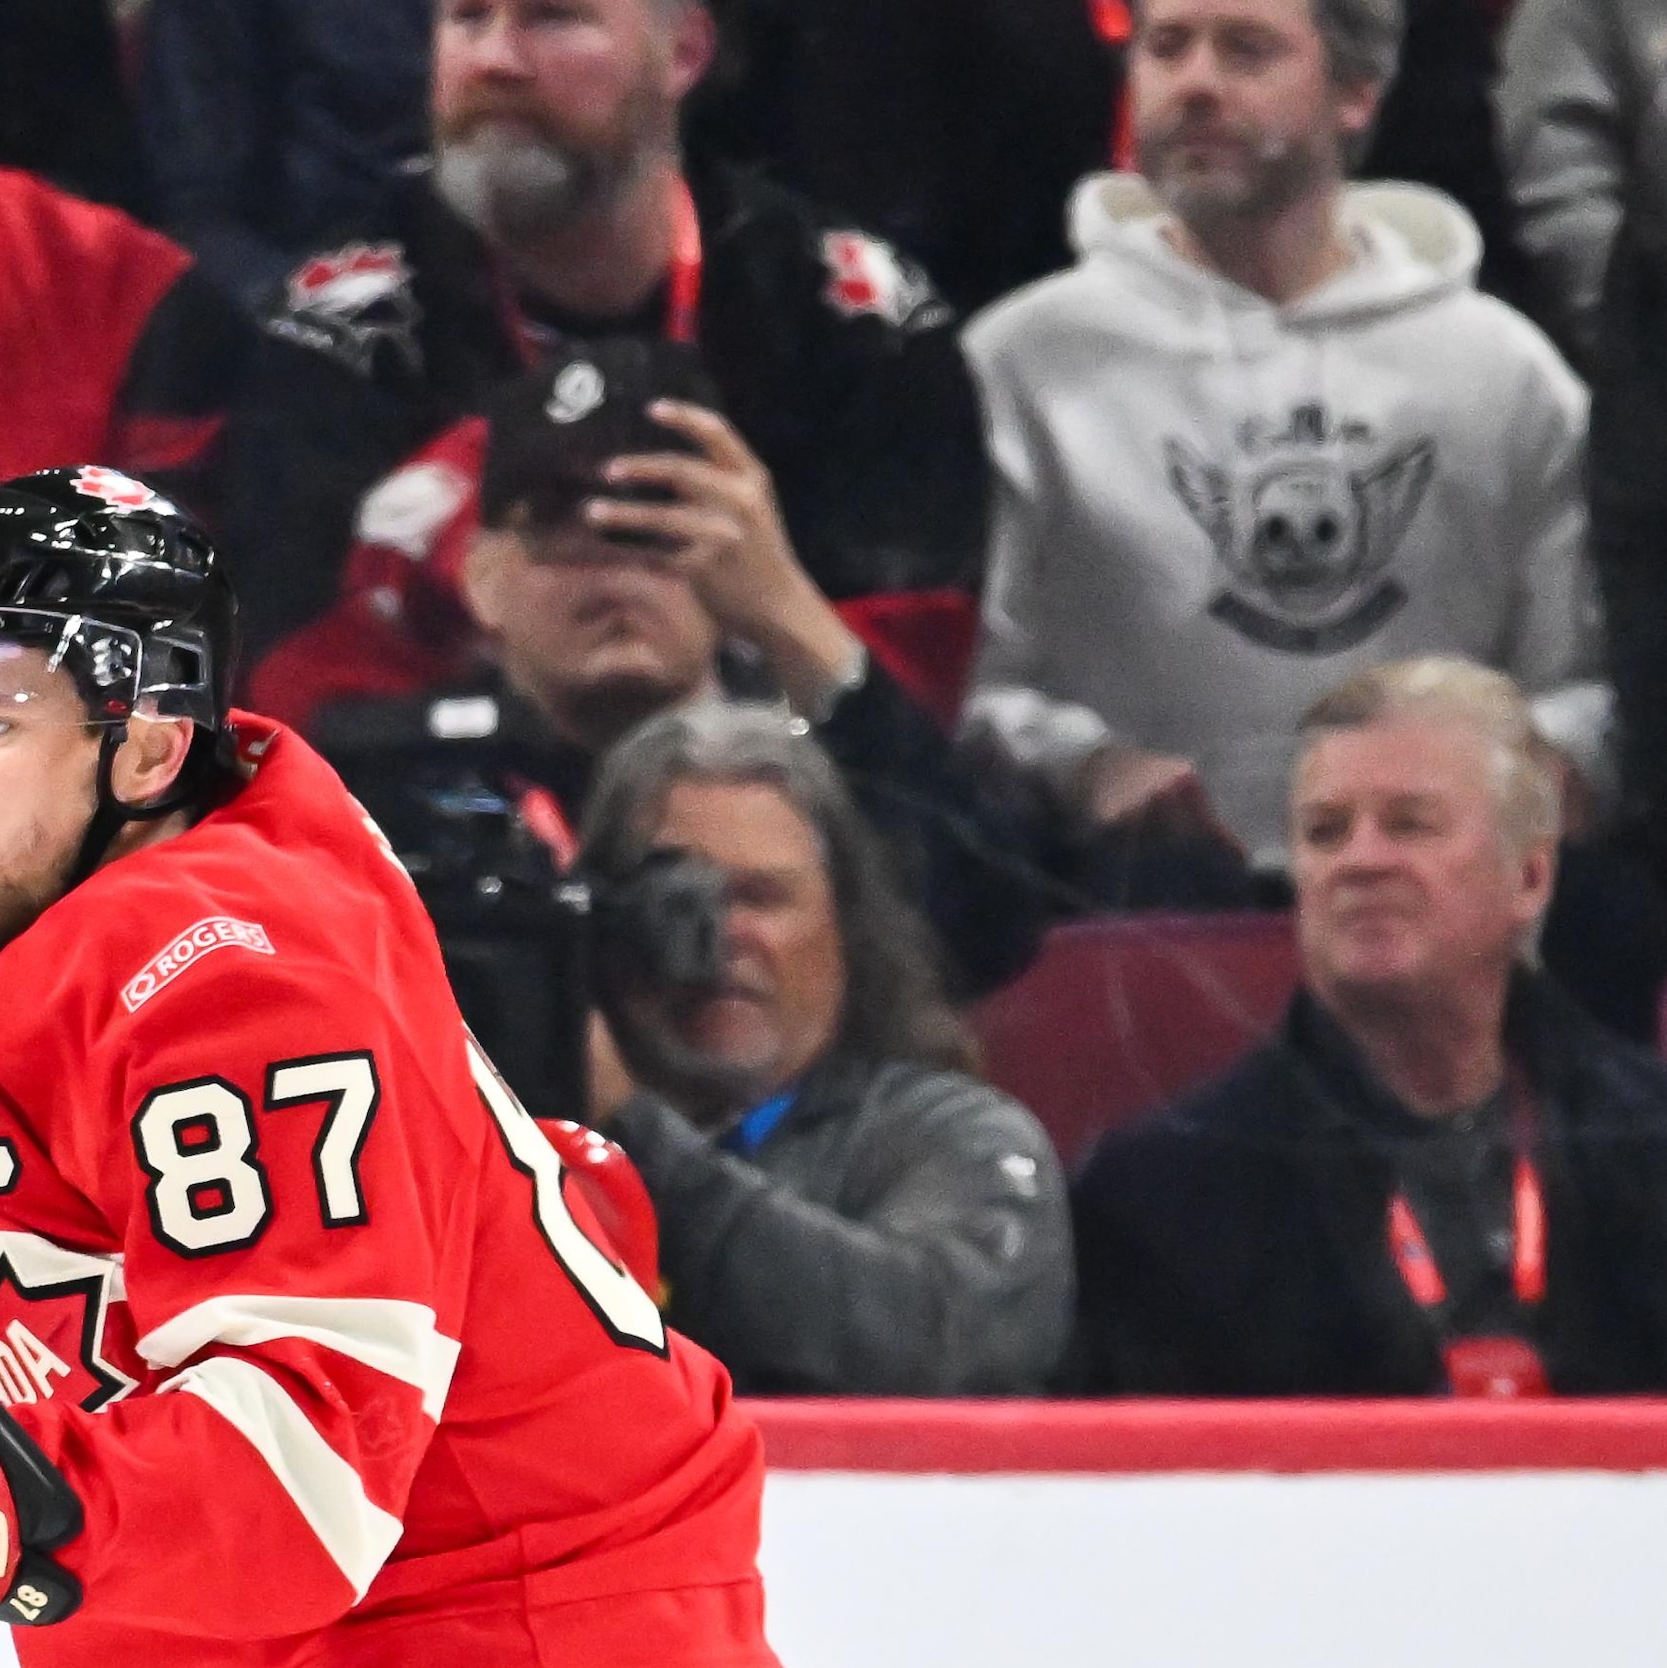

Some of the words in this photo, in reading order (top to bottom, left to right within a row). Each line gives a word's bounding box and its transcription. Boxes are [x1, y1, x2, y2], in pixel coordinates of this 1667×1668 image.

[156, 922, 265, 977] ROGERS
[132, 1048, 383, 1258] 87
[10, 1584, 49, 1621] 87
